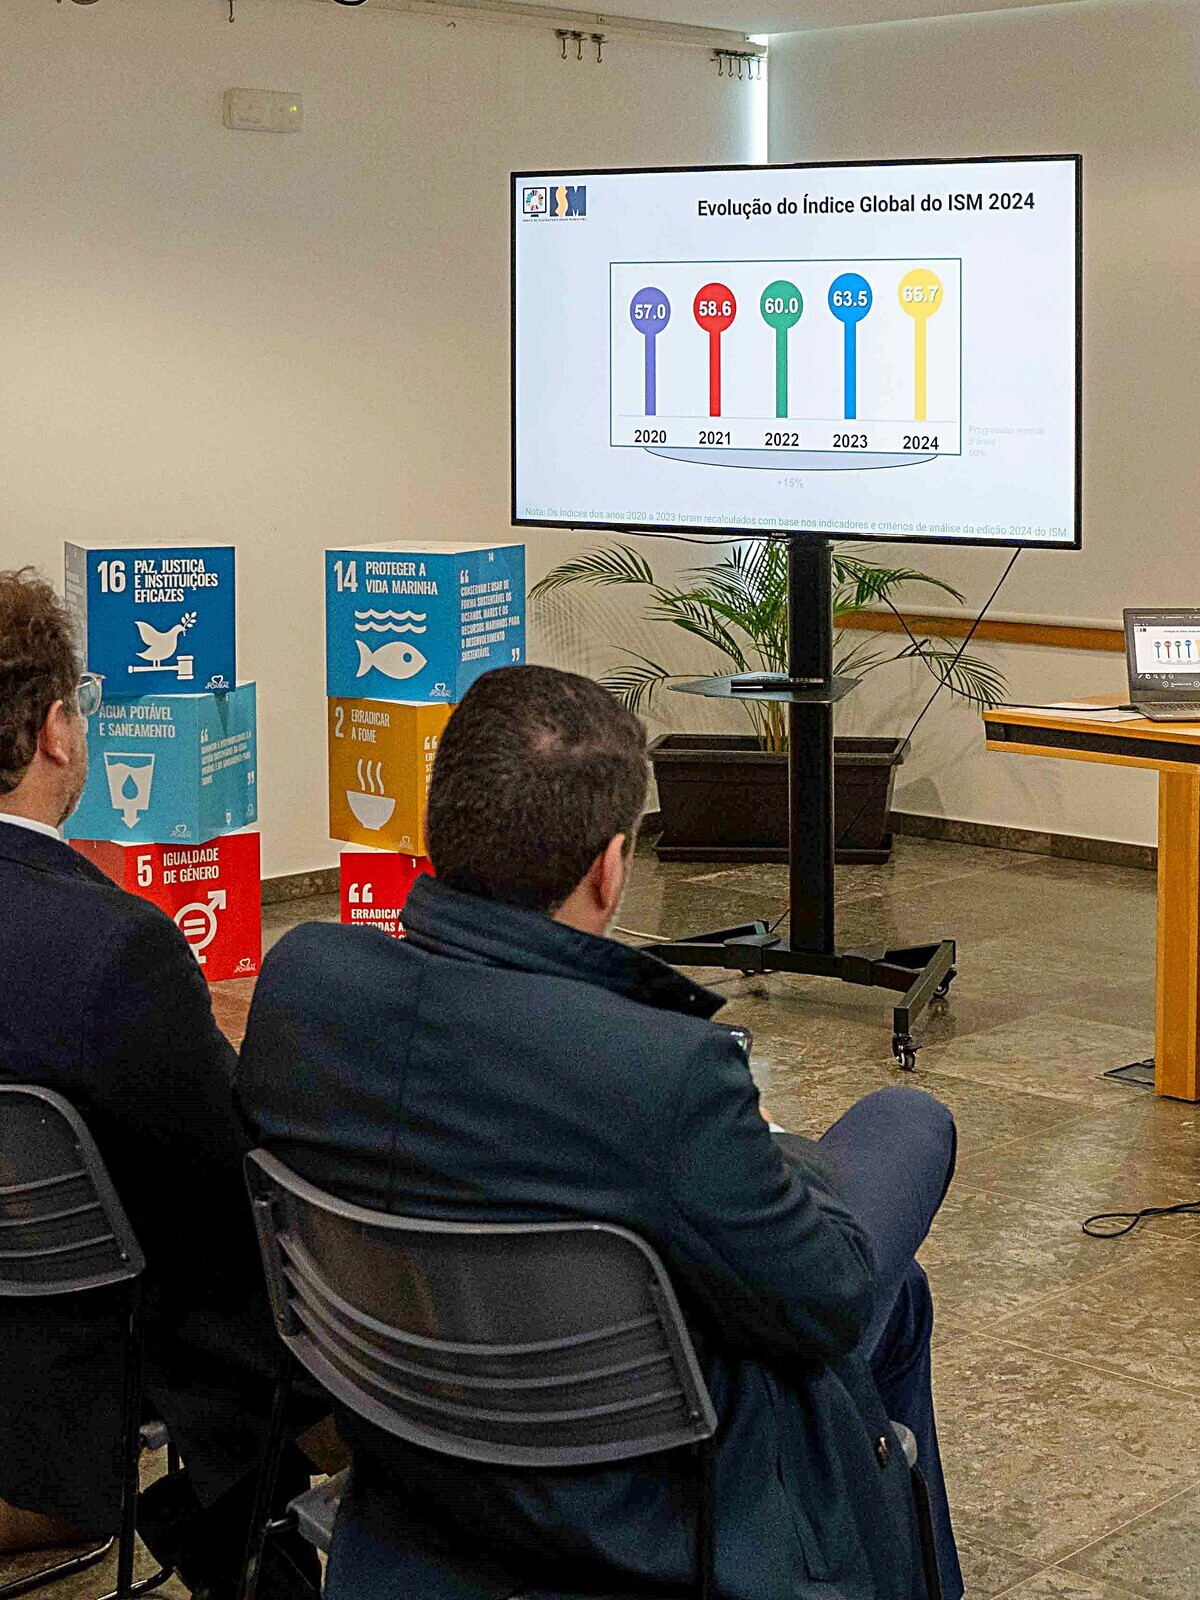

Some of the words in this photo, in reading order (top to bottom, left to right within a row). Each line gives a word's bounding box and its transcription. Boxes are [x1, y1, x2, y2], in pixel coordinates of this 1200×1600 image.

[698, 199, 771, 219] Evolução
[777, 198, 797, 214] do
[803, 194, 854, 213] Índice
[860, 195, 915, 213] Global
[921, 195, 942, 211] do
[949, 194, 983, 211] ISM
[989, 192, 1035, 209] 2024
[833, 290, 867, 306] 63.5
[902, 286, 939, 302] 65.7
[634, 304, 666, 319] 57.0
[699, 301, 731, 317] 58.6
[765, 298, 798, 314] 60.0
[634, 429, 667, 443] 2020
[699, 431, 732, 446] 2021
[765, 432, 799, 447] 2022
[832, 434, 868, 448] 2023
[903, 435, 939, 450] 2024
[777, 477, 803, 488] +15%
[525, 508, 546, 516] Nota:
[589, 510, 603, 518] dos
[627, 511, 646, 520] 2020
[656, 512, 675, 521] 2023
[678, 513, 702, 522] foram
[704, 514, 755, 524] recalculados
[758, 517, 776, 525] com
[779, 517, 798, 526] base
[819, 519, 868, 529] indicadores
[878, 521, 913, 531] critérios
[916, 522, 927, 532] de
[929, 523, 960, 533] análise
[964, 524, 974, 534] da
[977, 525, 1006, 536] edição
[1009, 526, 1032, 535] 2024
[1035, 527, 1046, 536] do
[1050, 528, 1066, 537] ISM
[488, 552, 494, 562] 14
[135, 560, 157, 575] PAZ,
[161, 559, 205, 576] JUSTIÇA
[366, 561, 415, 576] PROTEGER
[419, 563, 426, 576] A
[98, 560, 126, 593] 16
[135, 576, 141, 588] E
[145, 572, 218, 590] INSTITUIÇÕES
[334, 560, 358, 593] 14
[366, 580, 388, 594] VIDA
[392, 580, 438, 595] MARINHA
[135, 589, 184, 603] EFICAZES
[506, 592, 511, 602] OS
[509, 616, 520, 626] PARA
[130, 703, 173, 720] POTÁVEL
[351, 709, 390, 727] ERRADICAR
[100, 723, 104, 736] E
[108, 724, 175, 738] SANEAMENTO
[335, 707, 344, 738] 2
[351, 727, 356, 740] A
[358, 727, 376, 743] FOME
[163, 848, 219, 866] IGUALDADE
[412, 858, 416, 868] 1
[137, 855, 152, 887] 5
[163, 870, 176, 884] DE
[180, 865, 219, 882] GÉNERO
